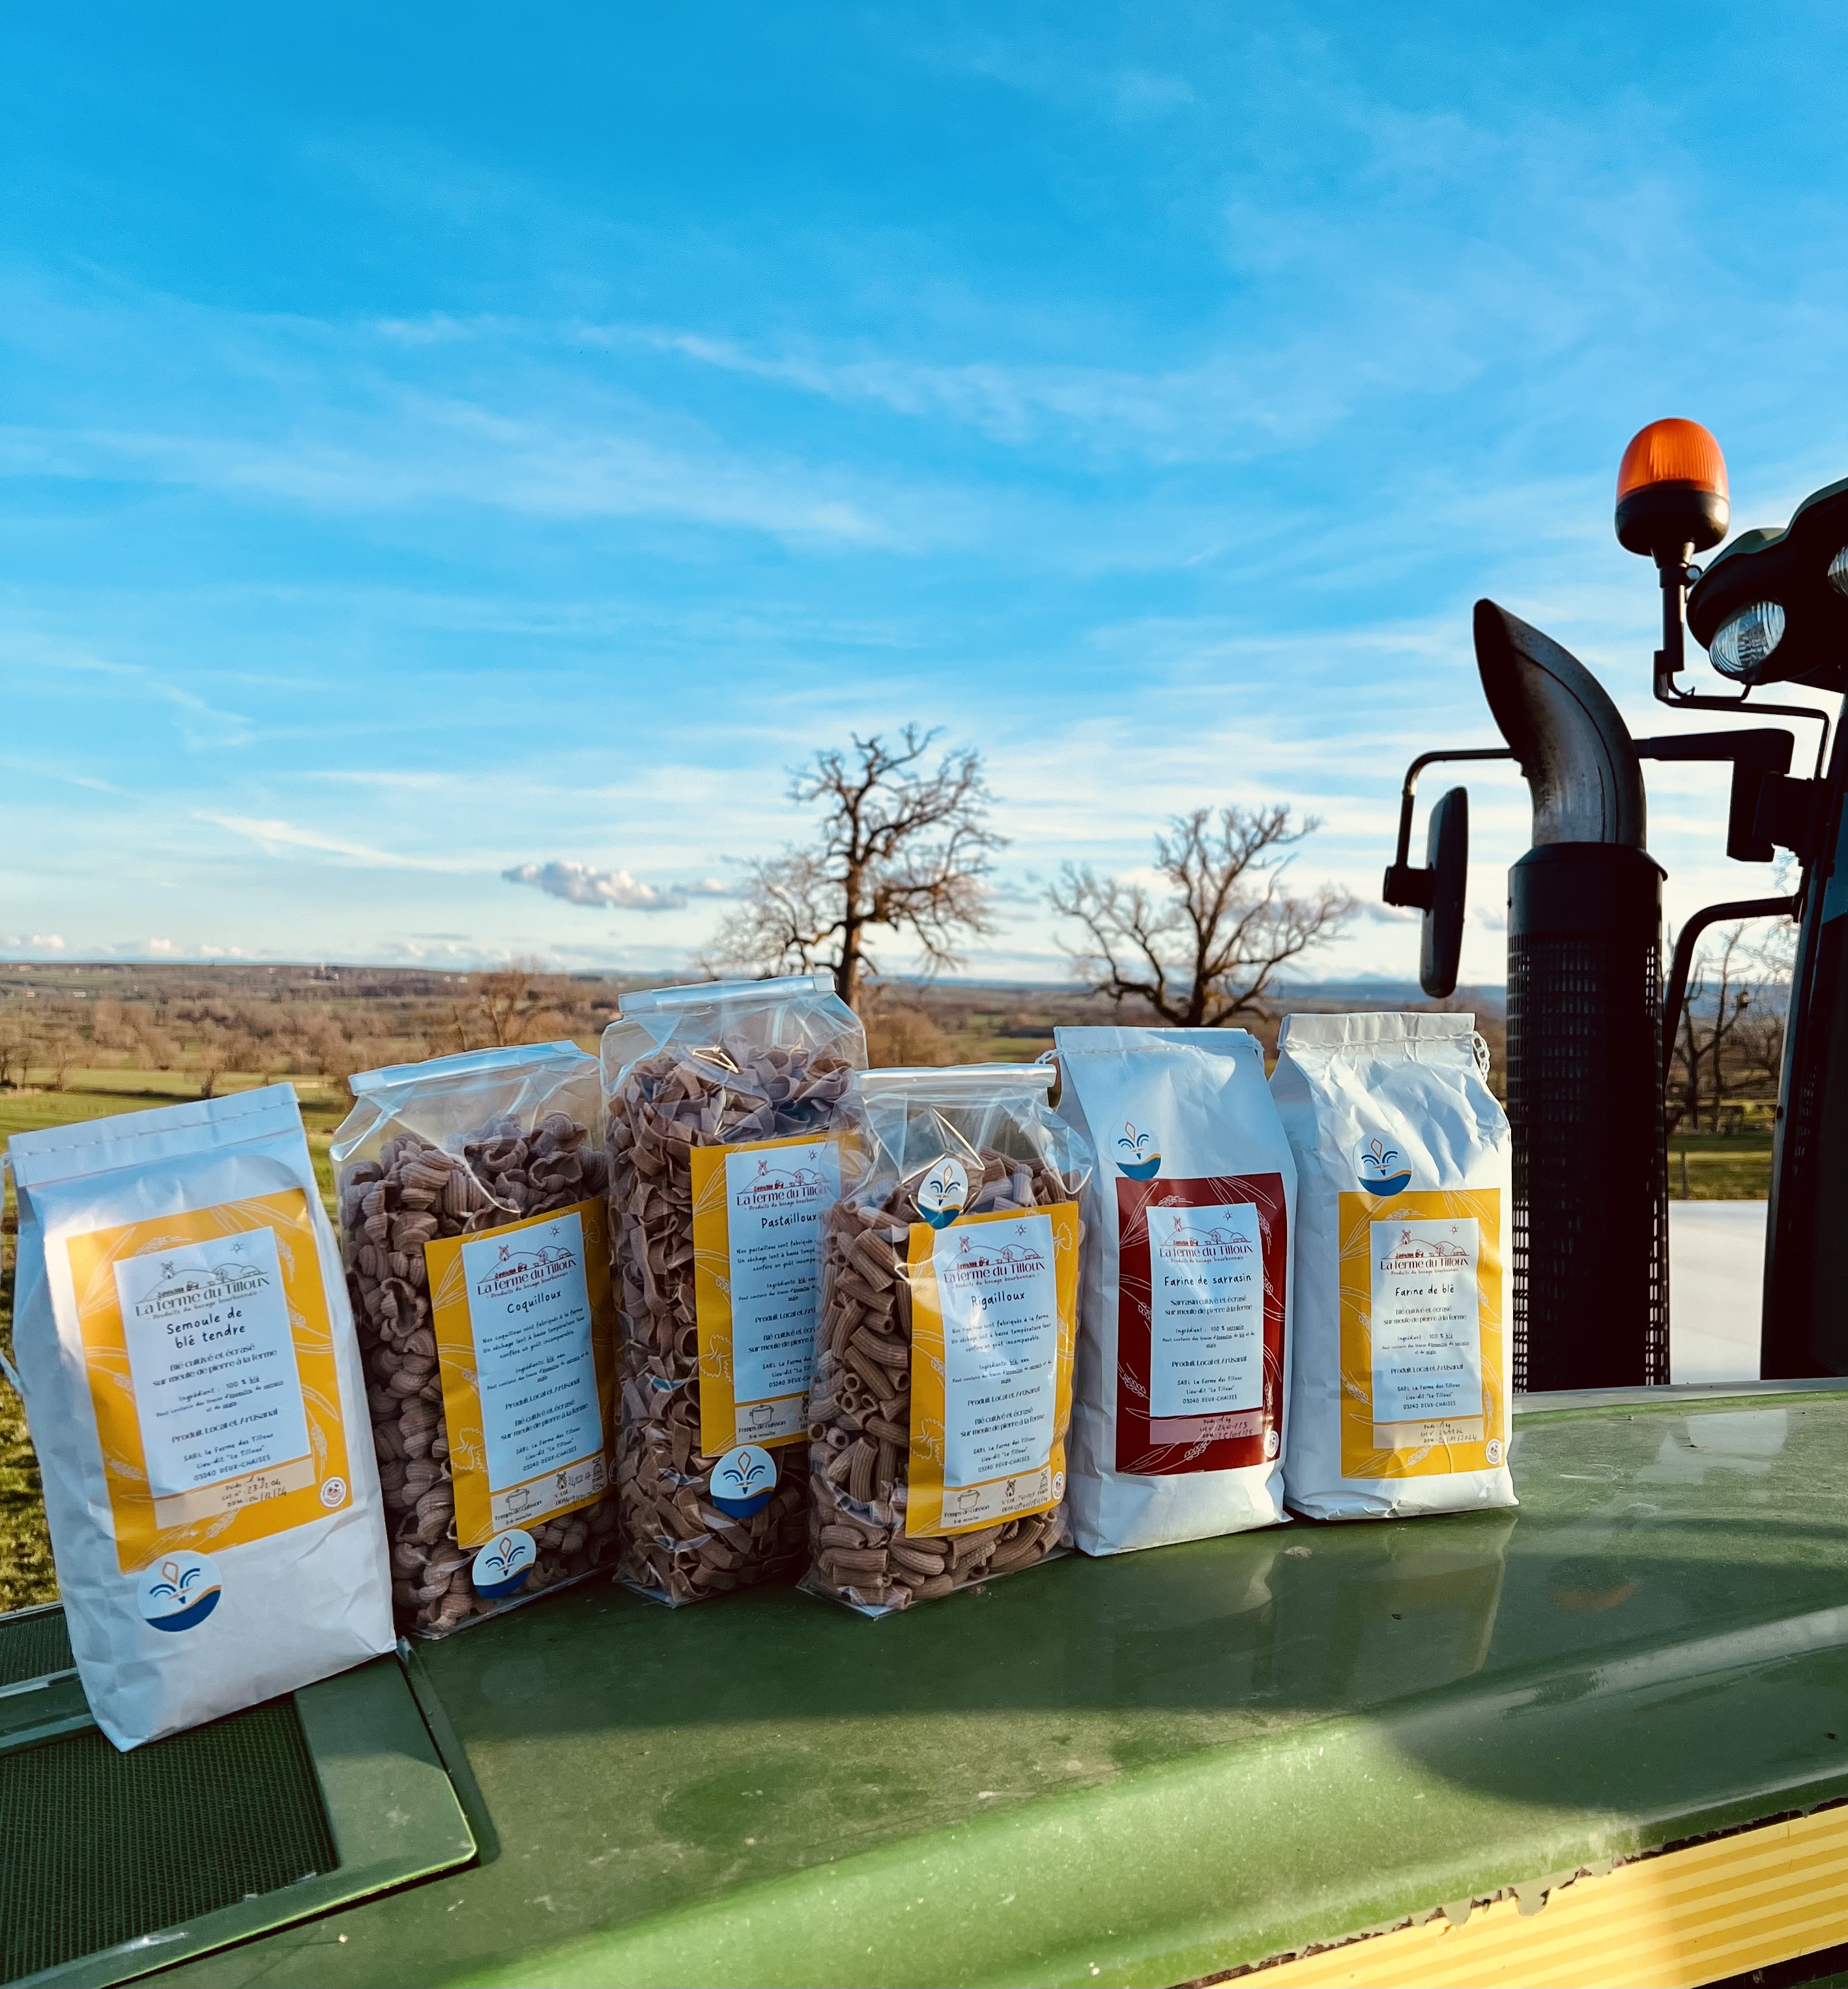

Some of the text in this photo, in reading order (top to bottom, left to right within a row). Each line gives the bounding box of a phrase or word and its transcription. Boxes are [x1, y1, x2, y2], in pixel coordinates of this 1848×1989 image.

[736, 1195, 750, 1206] La
[753, 1192, 785, 1204] ferme
[786, 1188, 799, 1199] du
[761, 1212, 816, 1229] Pastailloux
[1159, 1244, 1253, 1257] La ferme du Tilloux
[944, 1257, 1045, 1283] La ferme du Tilloux
[1380, 1257, 1469, 1270] La ferme du Tilloux
[477, 1257, 577, 1295] La ferme du Tilloux
[1164, 1272, 1252, 1287] Farine de sarrasin
[136, 1278, 270, 1317] La ferme du Tilloux
[1395, 1283, 1454, 1296] Farine de blé
[507, 1290, 561, 1313] Coquilloux
[971, 1290, 1024, 1310] Rigailloux
[166, 1306, 242, 1334] Semoule de
[755, 1313, 779, 1323] Produit
[779, 1310, 796, 1319] Local
[175, 1323, 245, 1349] blé tendre
[760, 1343, 781, 1351] meule
[790, 1337, 809, 1347] pierre
[152, 1378, 167, 1386] sur
[168, 1371, 195, 1383] meule
[208, 1361, 235, 1374] pierre
[252, 1350, 277, 1361] ferme
[505, 1397, 529, 1410] Produit
[529, 1390, 546, 1401] Local
[967, 1397, 990, 1407] Produit
[991, 1393, 1007, 1403] Local
[1201, 1394, 1237, 1403] DEUX-CHAISES
[171, 1429, 204, 1443] Produit
[204, 1422, 228, 1434] Local
[194, 1454, 270, 1481] 03240 DEUX-CHAISES
[977, 1455, 1030, 1472] 03240 DEUX-CHAISES
